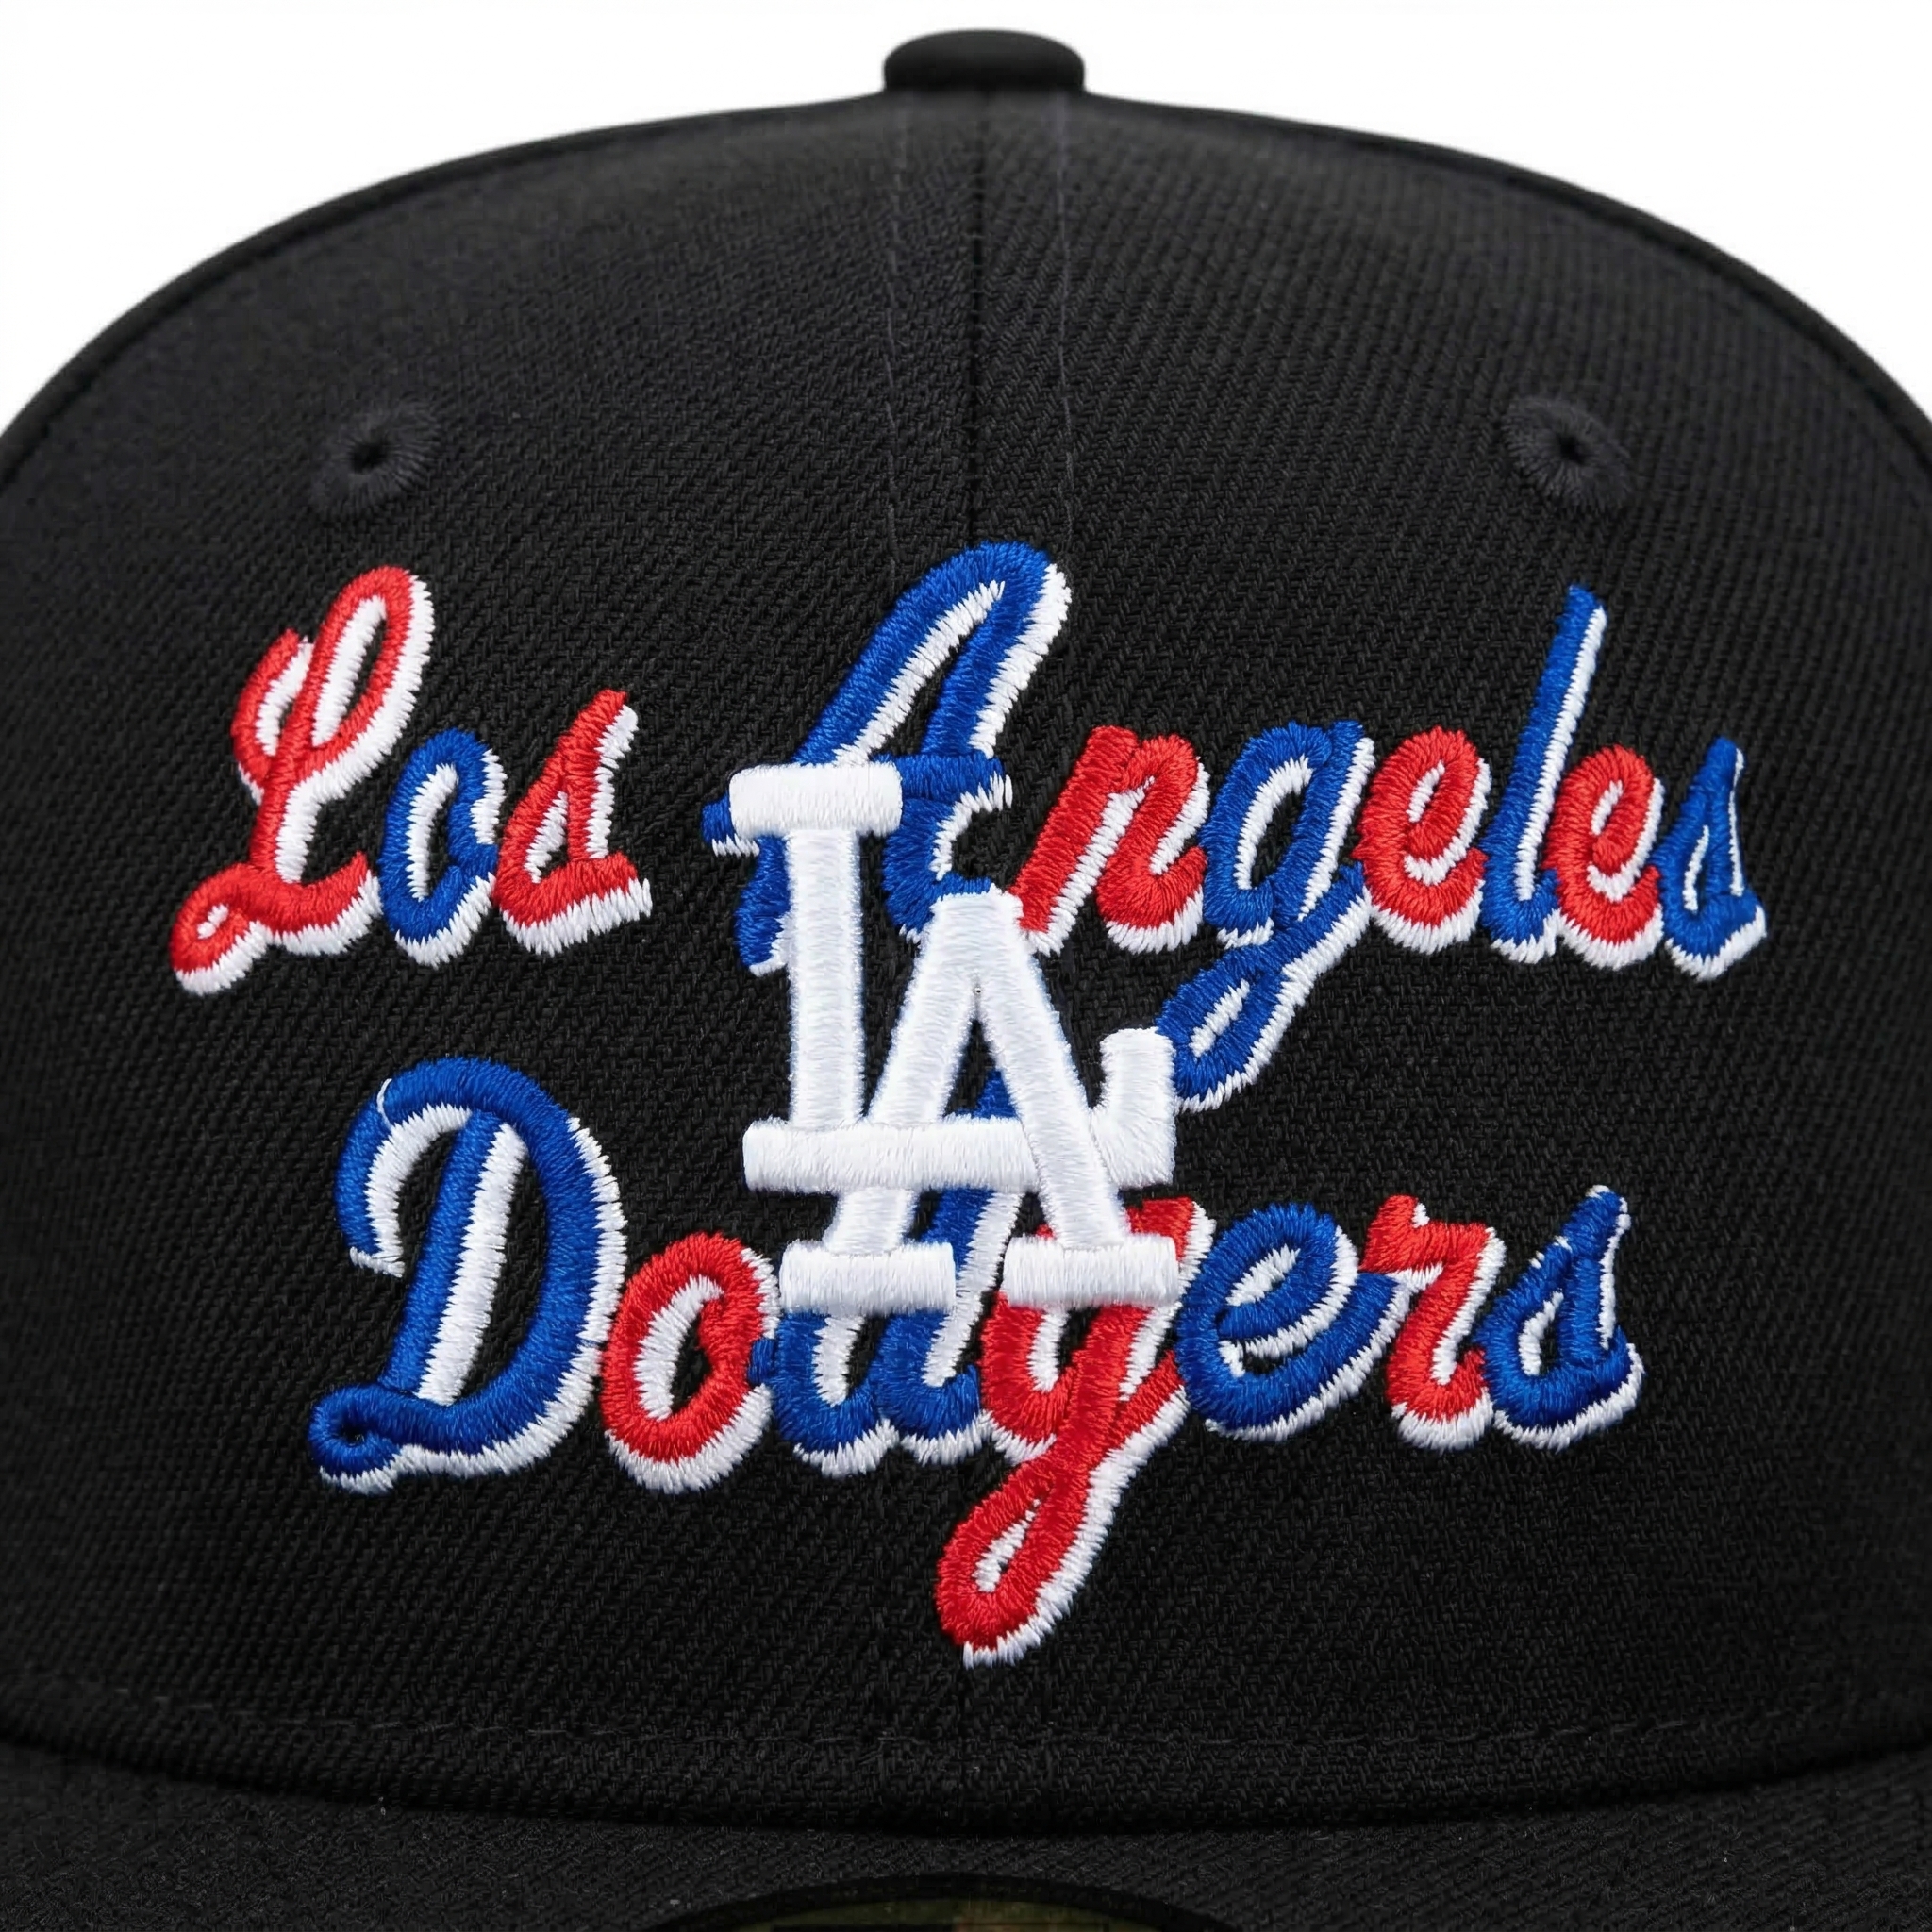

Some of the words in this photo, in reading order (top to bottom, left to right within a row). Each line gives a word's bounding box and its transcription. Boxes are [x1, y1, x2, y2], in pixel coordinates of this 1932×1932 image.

[170, 565, 652, 995] Los
[703, 541, 1767, 1111] Angeles
[729, 760, 1178, 1313] LA
